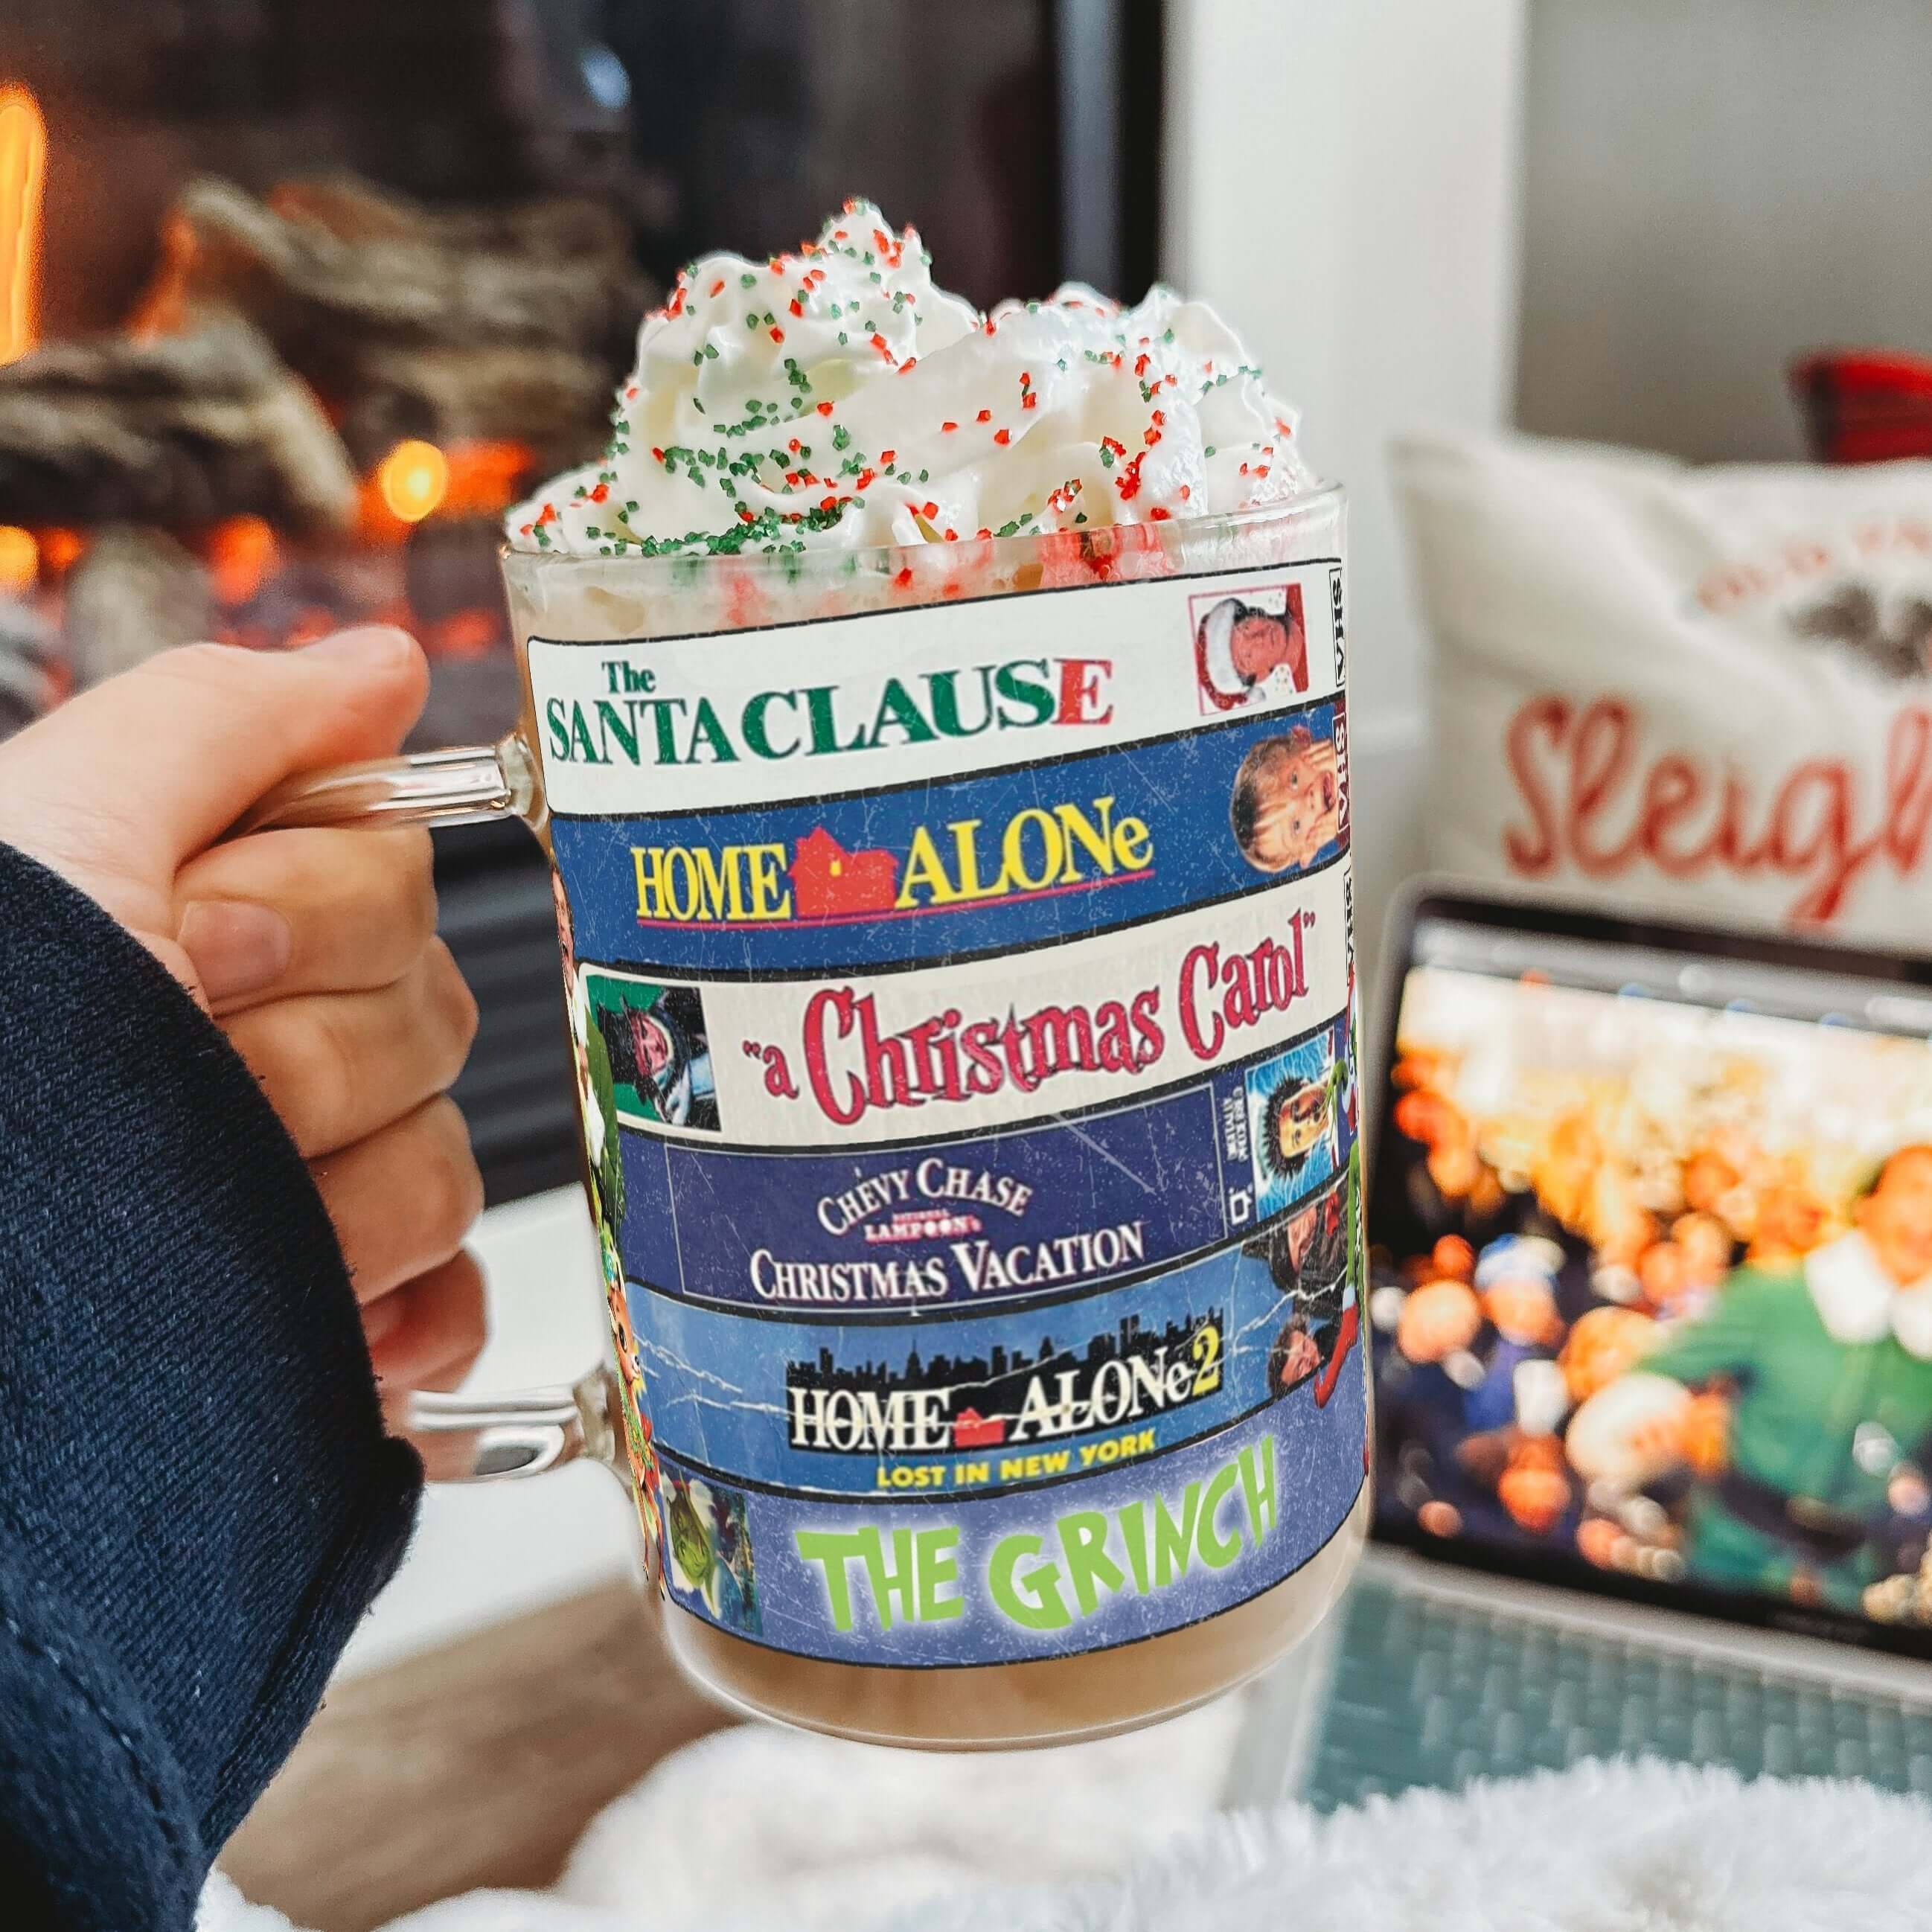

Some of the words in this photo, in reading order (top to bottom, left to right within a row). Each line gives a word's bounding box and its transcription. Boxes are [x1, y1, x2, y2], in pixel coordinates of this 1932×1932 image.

[546, 697, 740, 765] SANTA
[741, 658, 1113, 760] CLAUSE
[602, 661, 656, 694] The
[631, 844, 791, 921] HOME
[804, 984, 1165, 1125] Christmas
[817, 1169, 909, 1235] CHEVY
[916, 1157, 1032, 1217] CHASE
[750, 1249, 948, 1302] CHRISTMAS
[951, 1221, 1144, 1292] VACATION
[789, 1386, 950, 1450] HOME
[877, 1466, 944, 1487] LOST
[956, 1462, 991, 1484] IN
[1000, 1450, 1071, 1480] NEW
[1080, 1428, 1156, 1467] YORK
[794, 1526, 965, 1631] THE
[988, 1435, 1278, 1631] GRINCH
